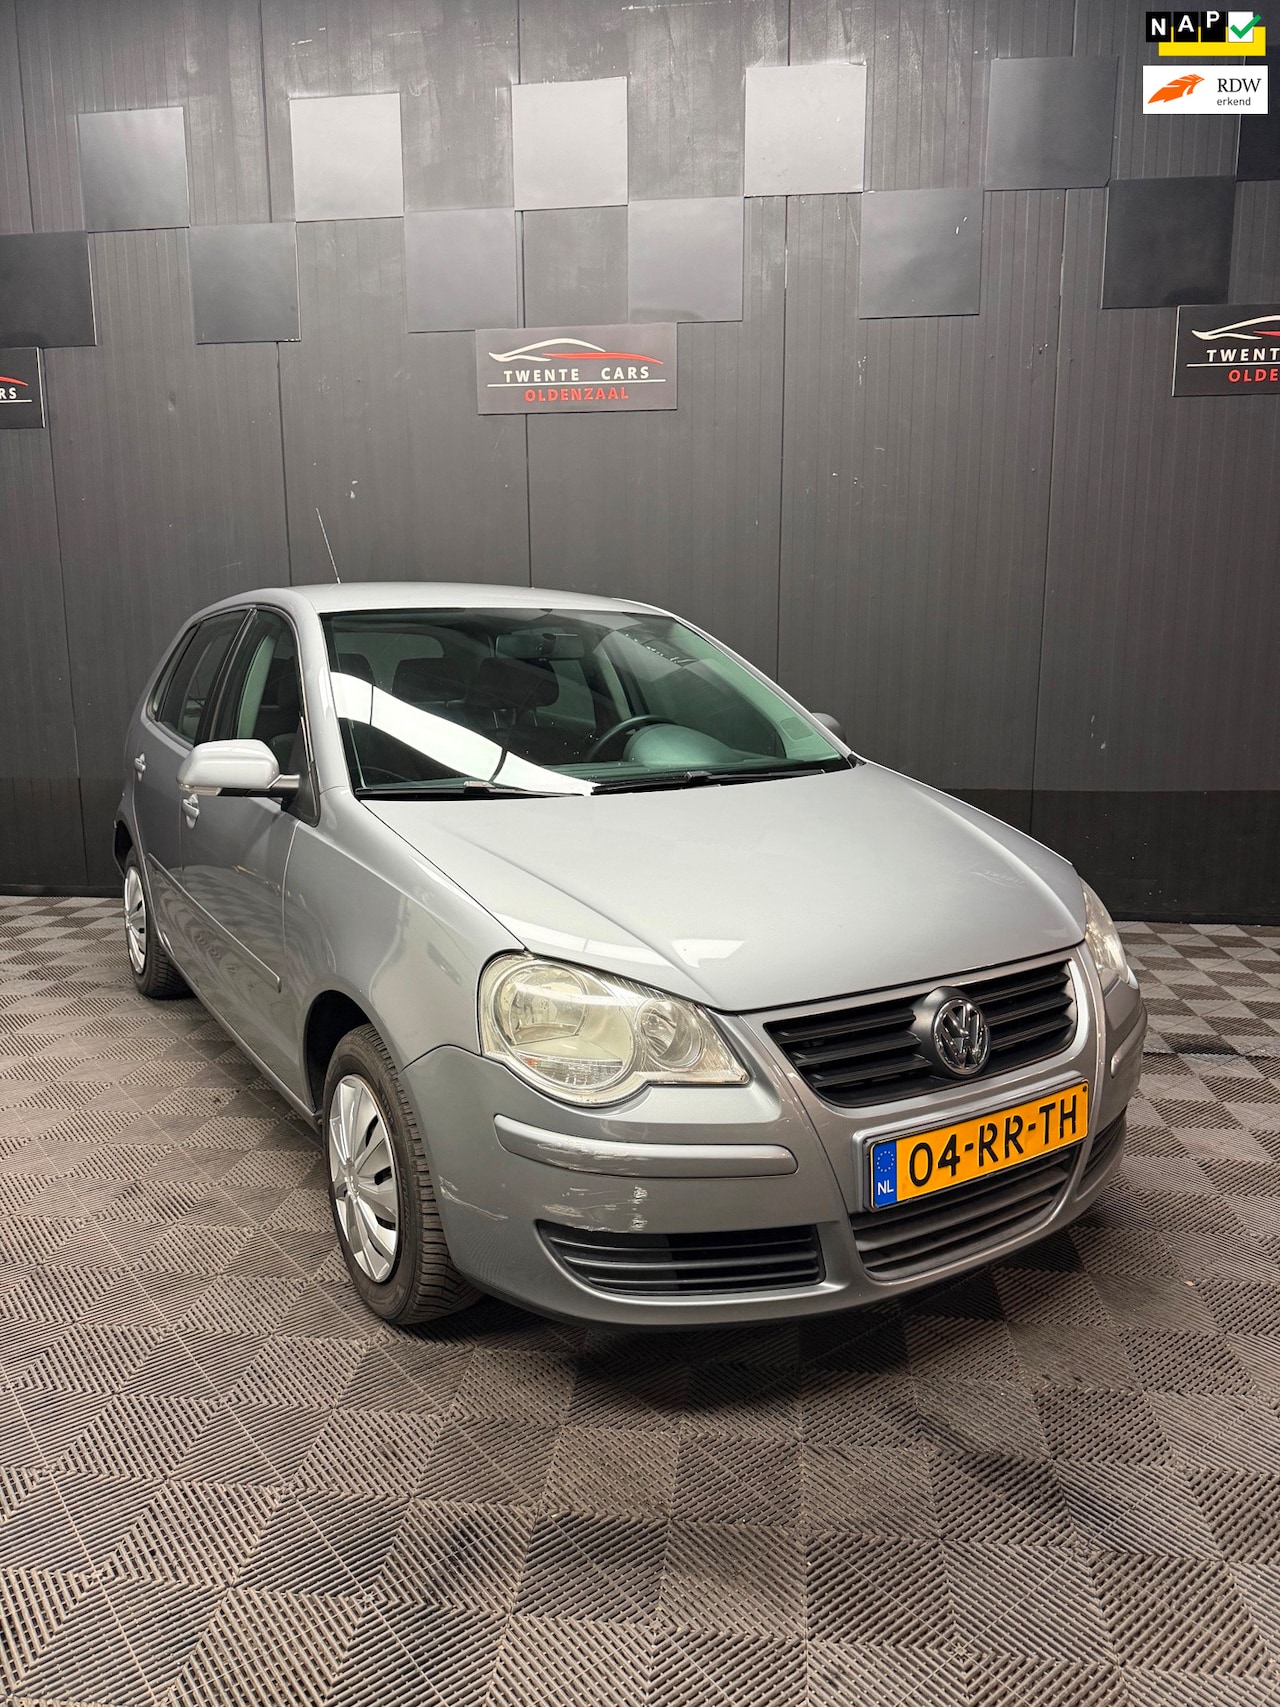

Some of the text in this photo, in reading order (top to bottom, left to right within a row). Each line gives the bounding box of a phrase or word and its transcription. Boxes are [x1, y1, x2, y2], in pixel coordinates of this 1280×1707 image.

[503, 366, 650, 383] TWENTE CARS
[524, 386, 629, 402] OLDENZAAL
[908, 1095, 1078, 1187] 04-RR-TH
[877, 1179, 894, 1196] NL
